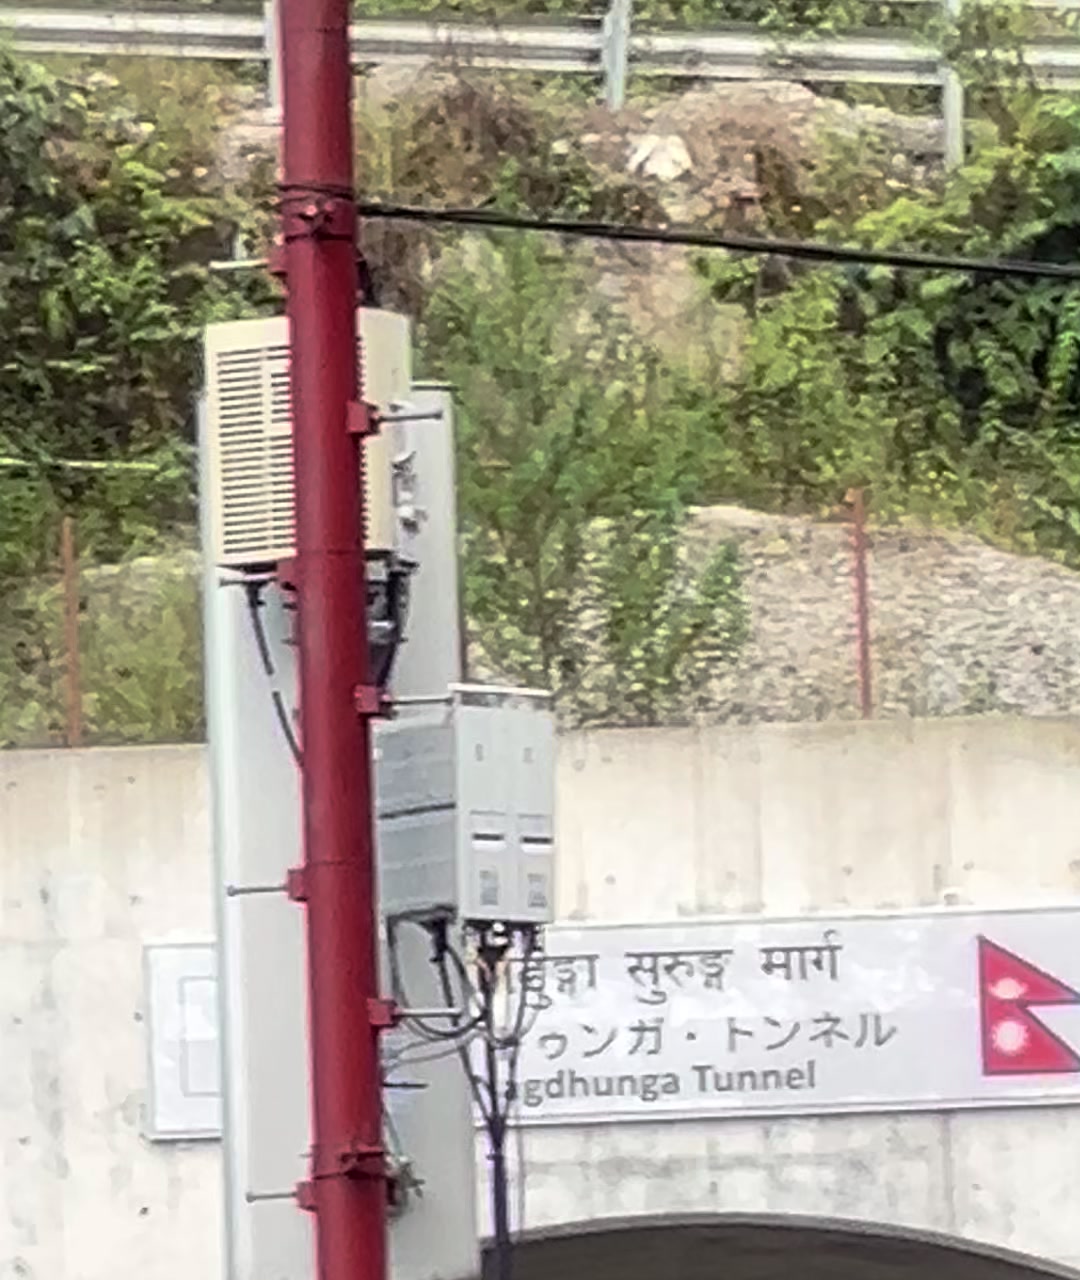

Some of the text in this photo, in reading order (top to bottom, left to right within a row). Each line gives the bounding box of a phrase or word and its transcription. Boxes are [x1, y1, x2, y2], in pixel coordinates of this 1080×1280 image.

[759, 928, 844, 982] मार्ग
[538, 1011, 899, 1061] ゥンガ・トンネル
[690, 1059, 817, 1093] Tunnel
